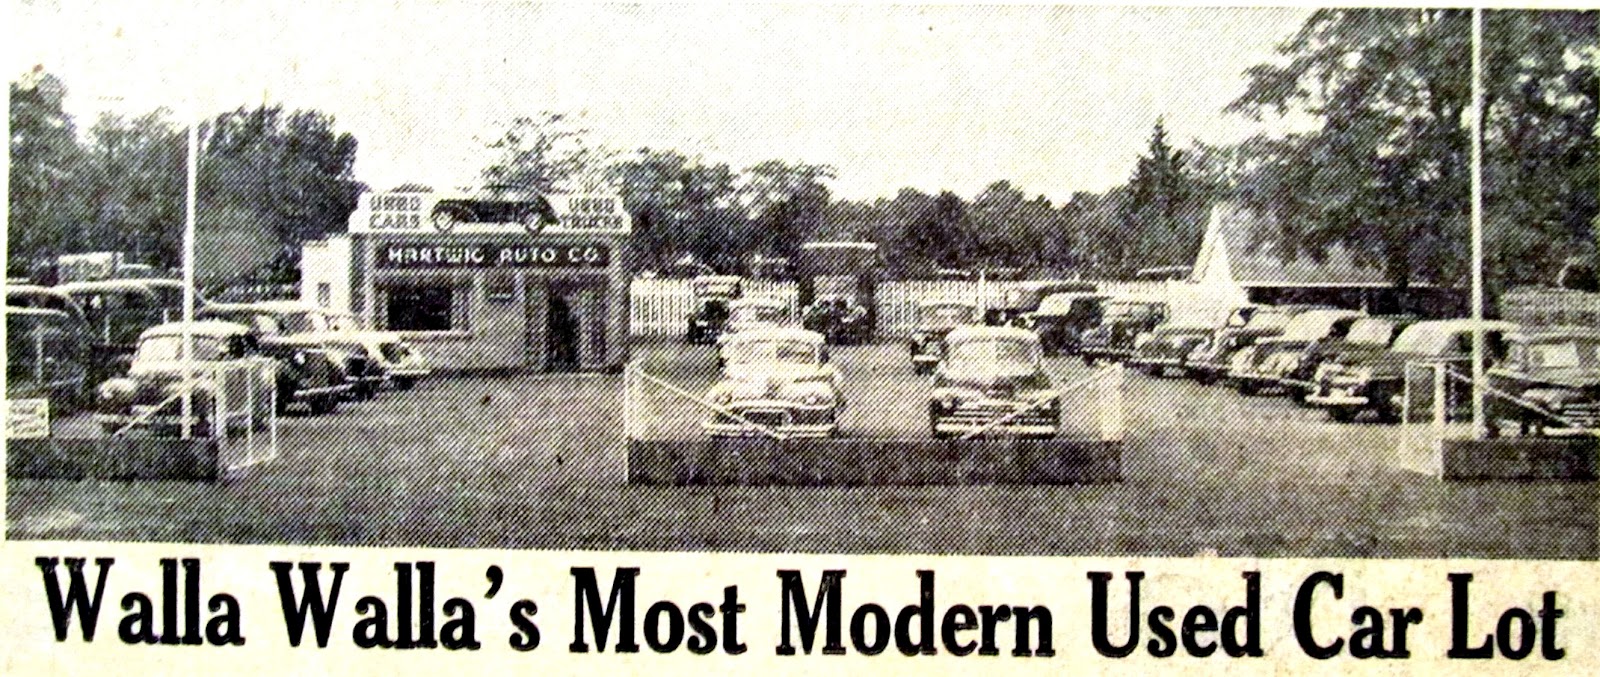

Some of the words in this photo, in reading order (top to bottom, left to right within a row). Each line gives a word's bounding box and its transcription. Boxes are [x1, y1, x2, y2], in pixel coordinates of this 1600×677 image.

[369, 195, 422, 212] USED
[568, 197, 615, 214] USED
[368, 212, 421, 230] CARS
[388, 247, 485, 264] HARTWIG
[499, 247, 556, 263] AUTO
[36, 556, 246, 647] Walla
[269, 561, 541, 652] Walla's
[569, 566, 748, 656] Most
[775, 569, 1056, 658] Modern
[1086, 571, 1264, 659] Used
[1293, 570, 1424, 660] Car
[1447, 572, 1566, 661] Lot
